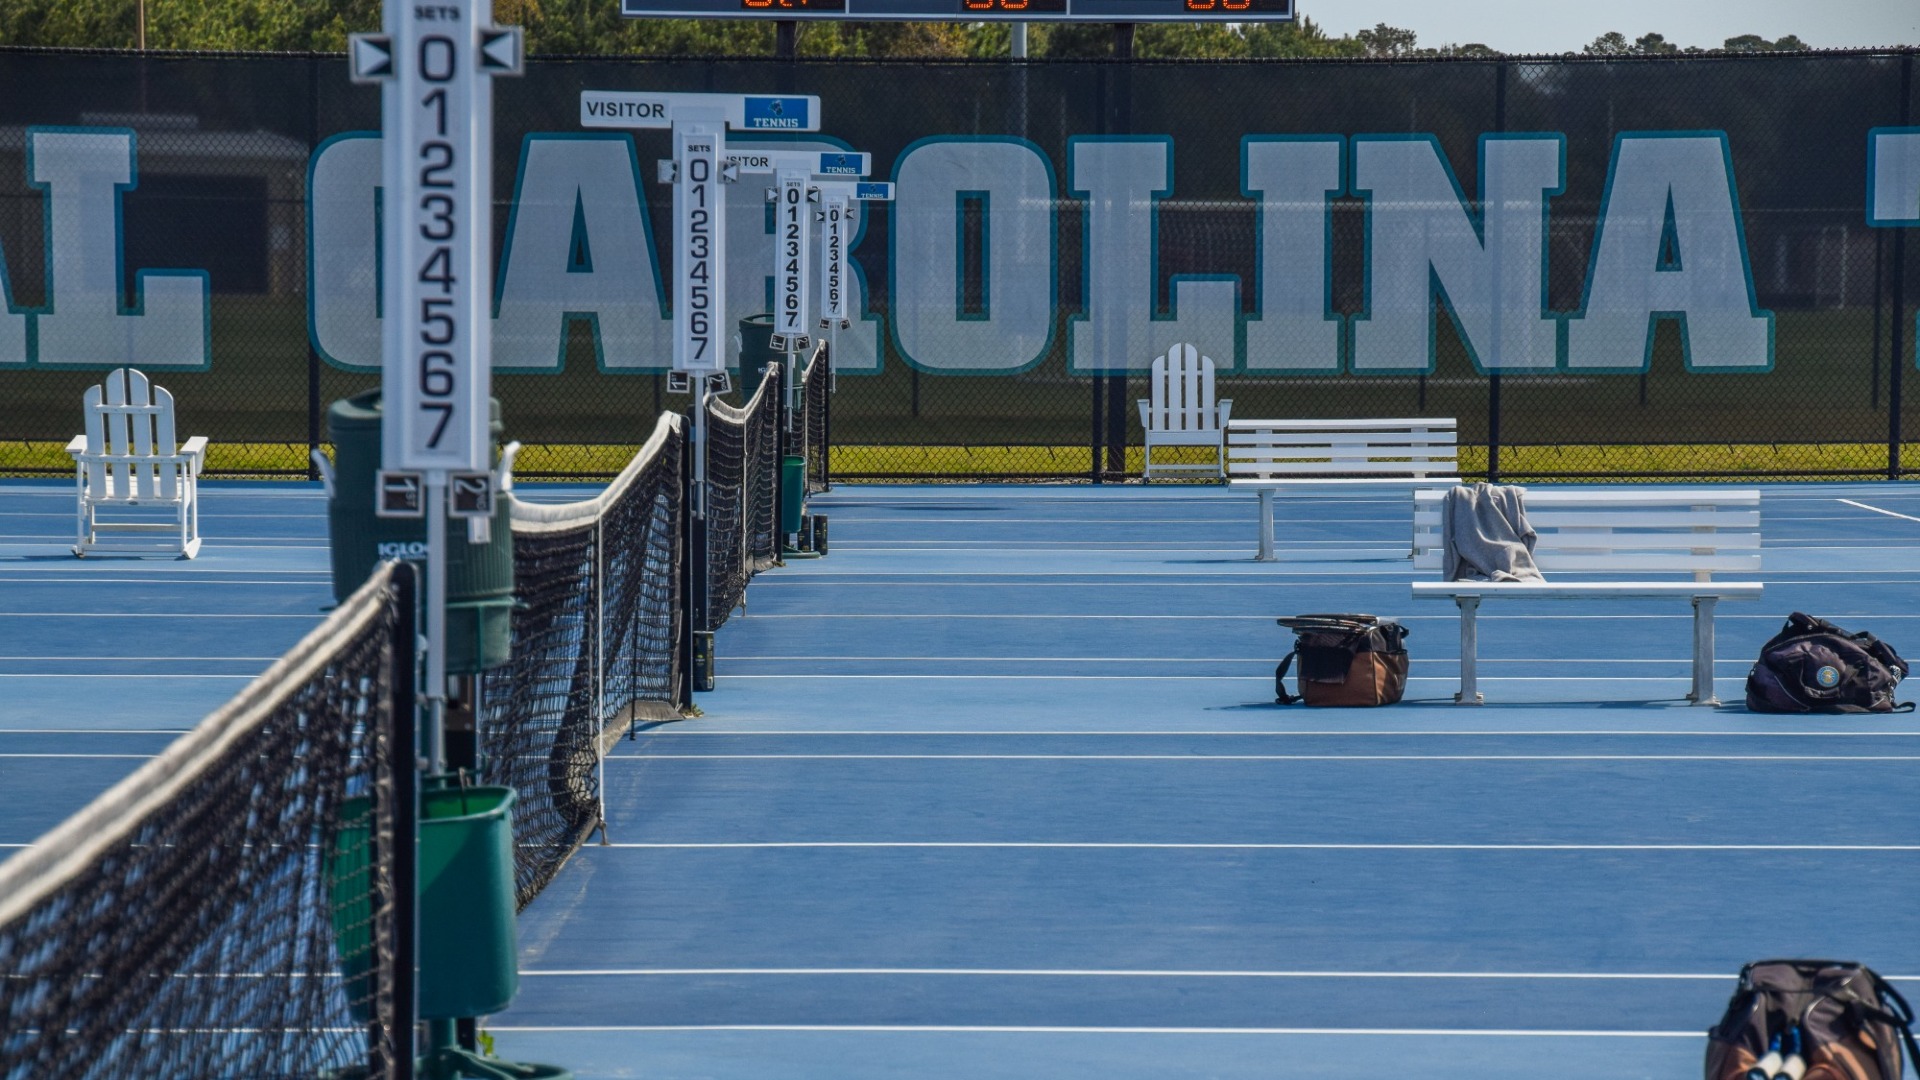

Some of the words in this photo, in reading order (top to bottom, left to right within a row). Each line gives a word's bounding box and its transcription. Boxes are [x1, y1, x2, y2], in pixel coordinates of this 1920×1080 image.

[414, 6, 461, 21] SETS
[417, 34, 458, 85] 0
[421, 87, 449, 138] 1
[586, 101, 665, 118] VISITOR
[753, 117, 799, 128] TENNIS
[687, 144, 711, 153] SETS
[419, 140, 456, 190] 2
[689, 158, 710, 183] 0
[825, 166, 856, 174] TENNIS
[691, 183, 705, 208] 1
[786, 187, 800, 205] 0
[419, 193, 457, 243] 3
[690, 209, 709, 234] 2
[787, 205, 797, 223] 1
[829, 208, 840, 222] 0
[786, 223, 800, 240] 2
[829, 222, 838, 235] 1
[690, 234, 709, 259] 3
[786, 240, 799, 258] 3
[829, 235, 840, 249] 2
[829, 248, 839, 262] 3
[417, 246, 458, 295] 4
[689, 260, 710, 284] 4
[785, 258, 800, 276] 4
[828, 261, 840, 275] 4
[785, 275, 799, 293] 5
[828, 274, 839, 288] 5
[690, 285, 709, 310] 5
[785, 293, 799, 310] 6
[828, 288, 839, 301] 6
[829, 300, 839, 313] 7
[420, 298, 457, 347] 5
[690, 310, 709, 335] 6
[785, 310, 799, 328] 7
[690, 336, 709, 360] 7
[419, 350, 456, 399] 6
[419, 401, 456, 450] 7
[378, 542, 428, 556] IGLO
